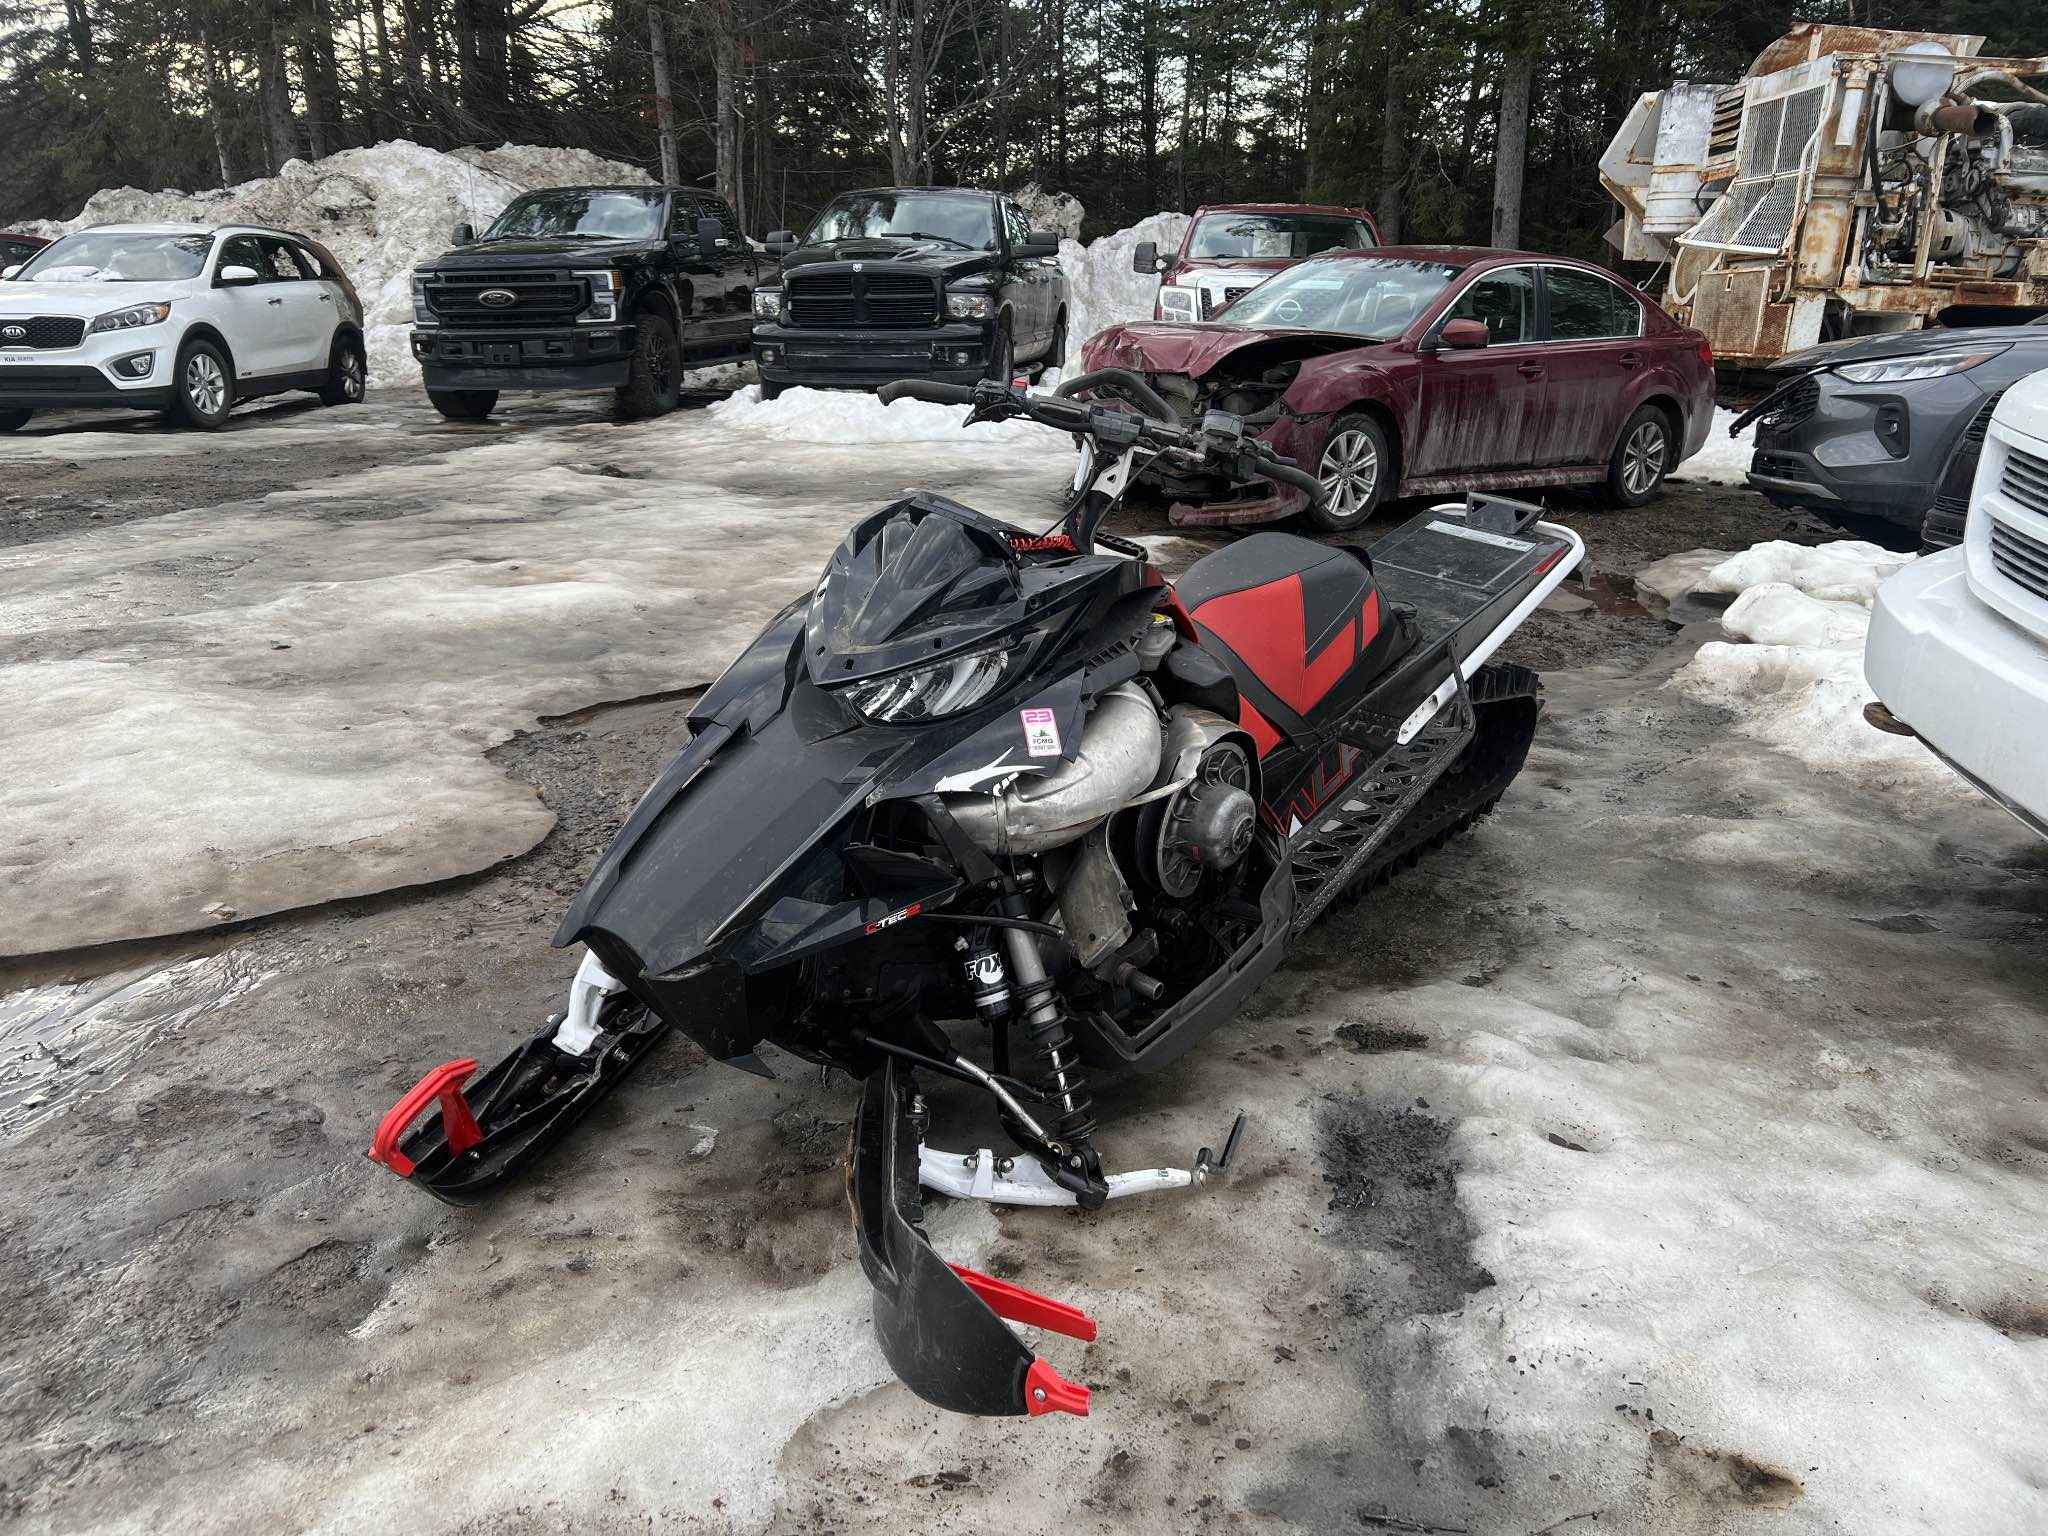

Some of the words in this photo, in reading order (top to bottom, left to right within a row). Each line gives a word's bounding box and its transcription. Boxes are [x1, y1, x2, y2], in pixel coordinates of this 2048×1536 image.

[5, 328, 21, 336] KIA
[1025, 711, 1052, 723] 23
[964, 952, 1004, 985] FOX
